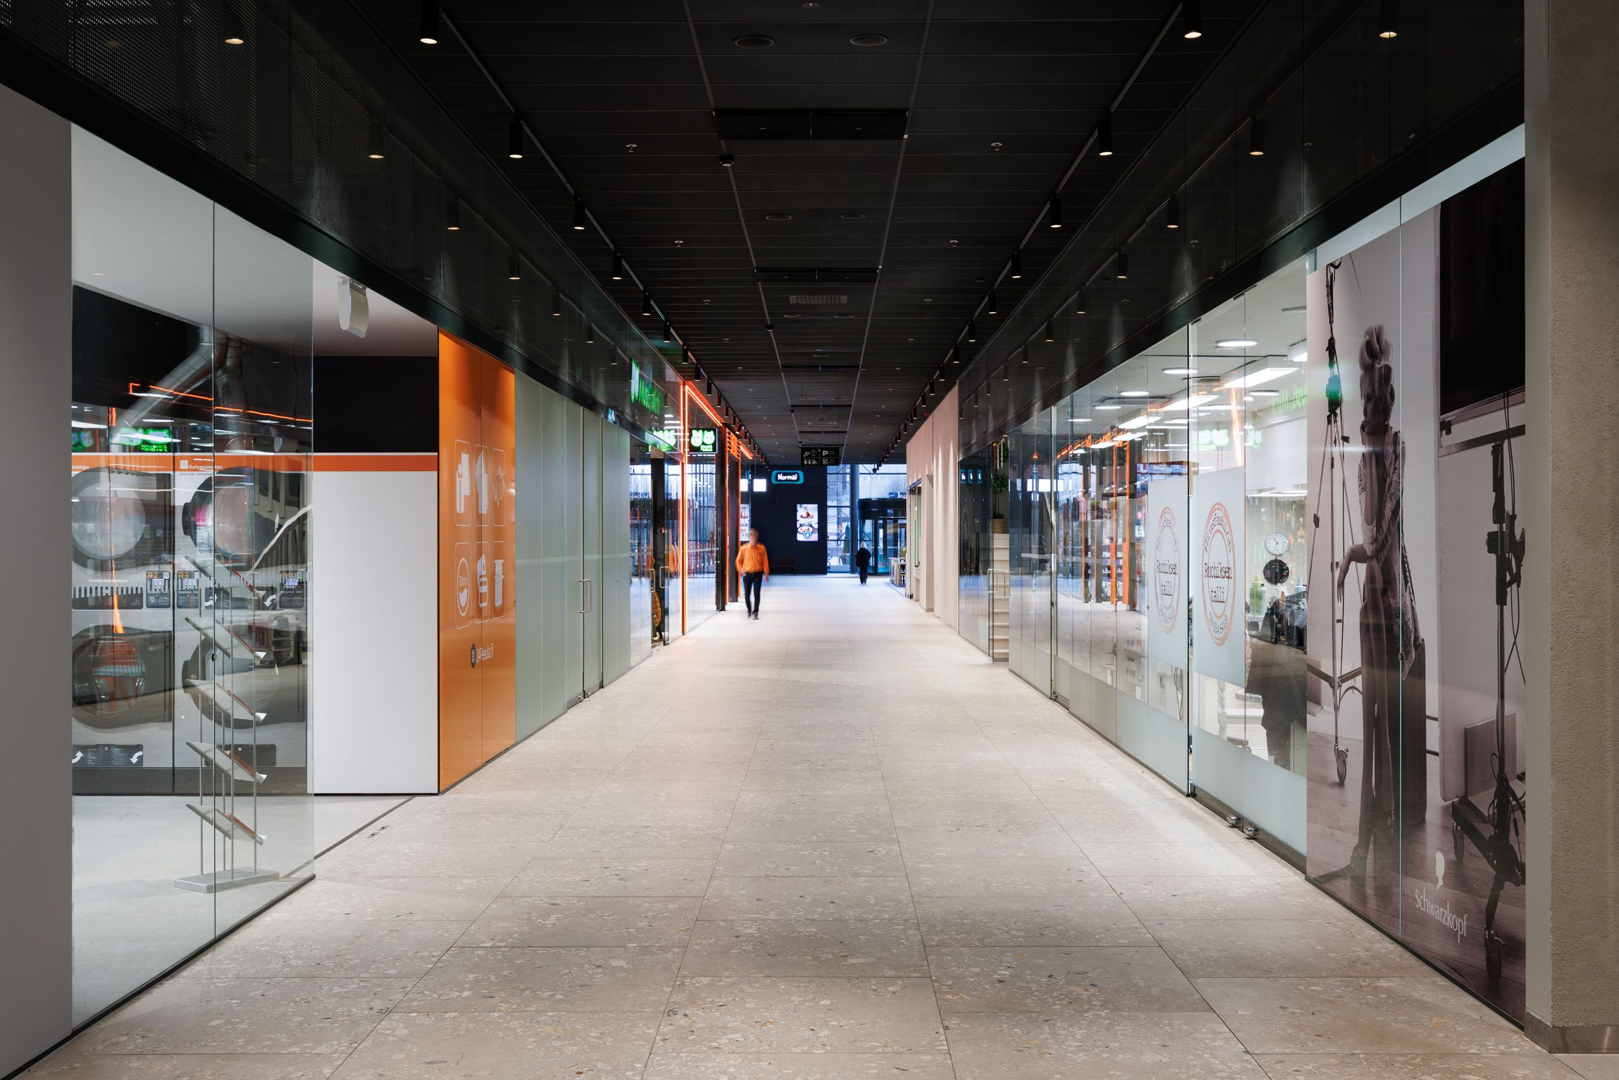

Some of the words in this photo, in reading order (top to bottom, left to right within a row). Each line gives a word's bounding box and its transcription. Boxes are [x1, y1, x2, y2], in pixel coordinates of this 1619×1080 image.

[777, 473, 798, 481] Normal
[147, 571, 159, 579] R2
[178, 571, 189, 579] R3
[1415, 887, 1468, 944] Schwarzkopf
